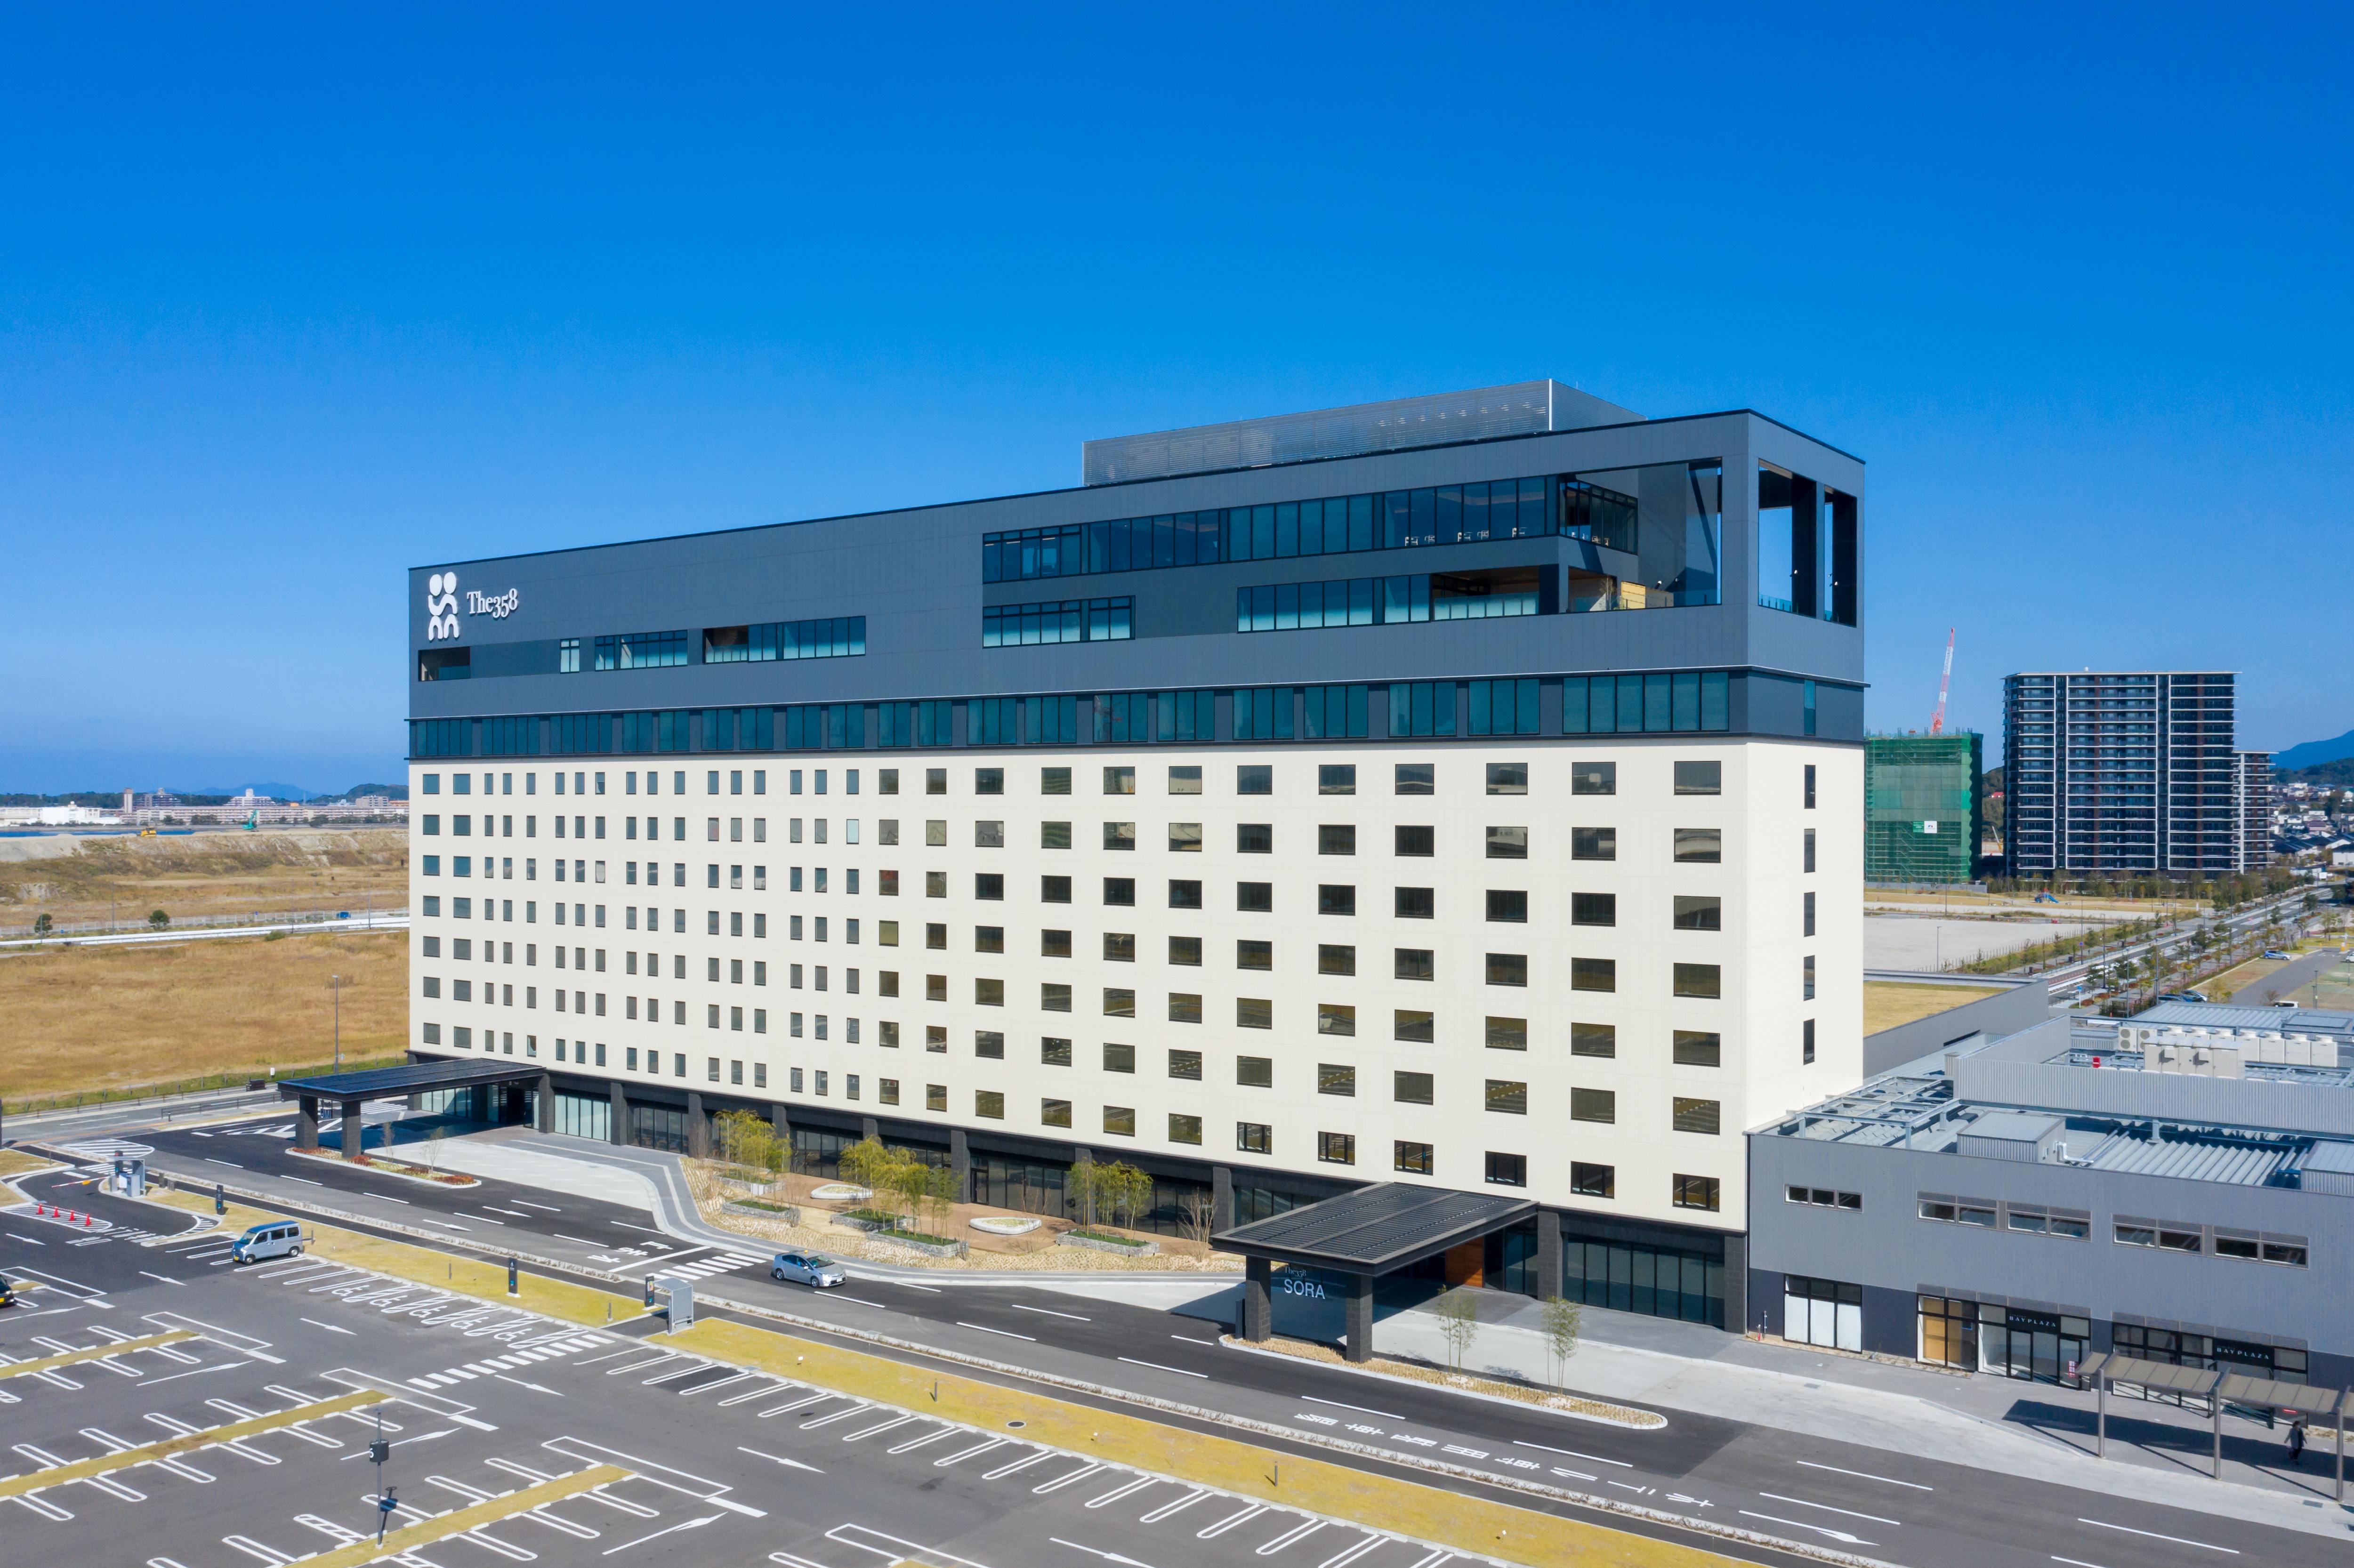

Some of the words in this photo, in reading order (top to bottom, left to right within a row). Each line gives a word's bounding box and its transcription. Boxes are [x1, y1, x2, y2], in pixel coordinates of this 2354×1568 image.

[467, 588, 518, 618] The358
[321, 1109, 331, 1119] UMI
[587, 1241, 674, 1263] 止まれ
[1285, 1266, 1306, 1277] The358
[1284, 1279, 1325, 1299] SORA
